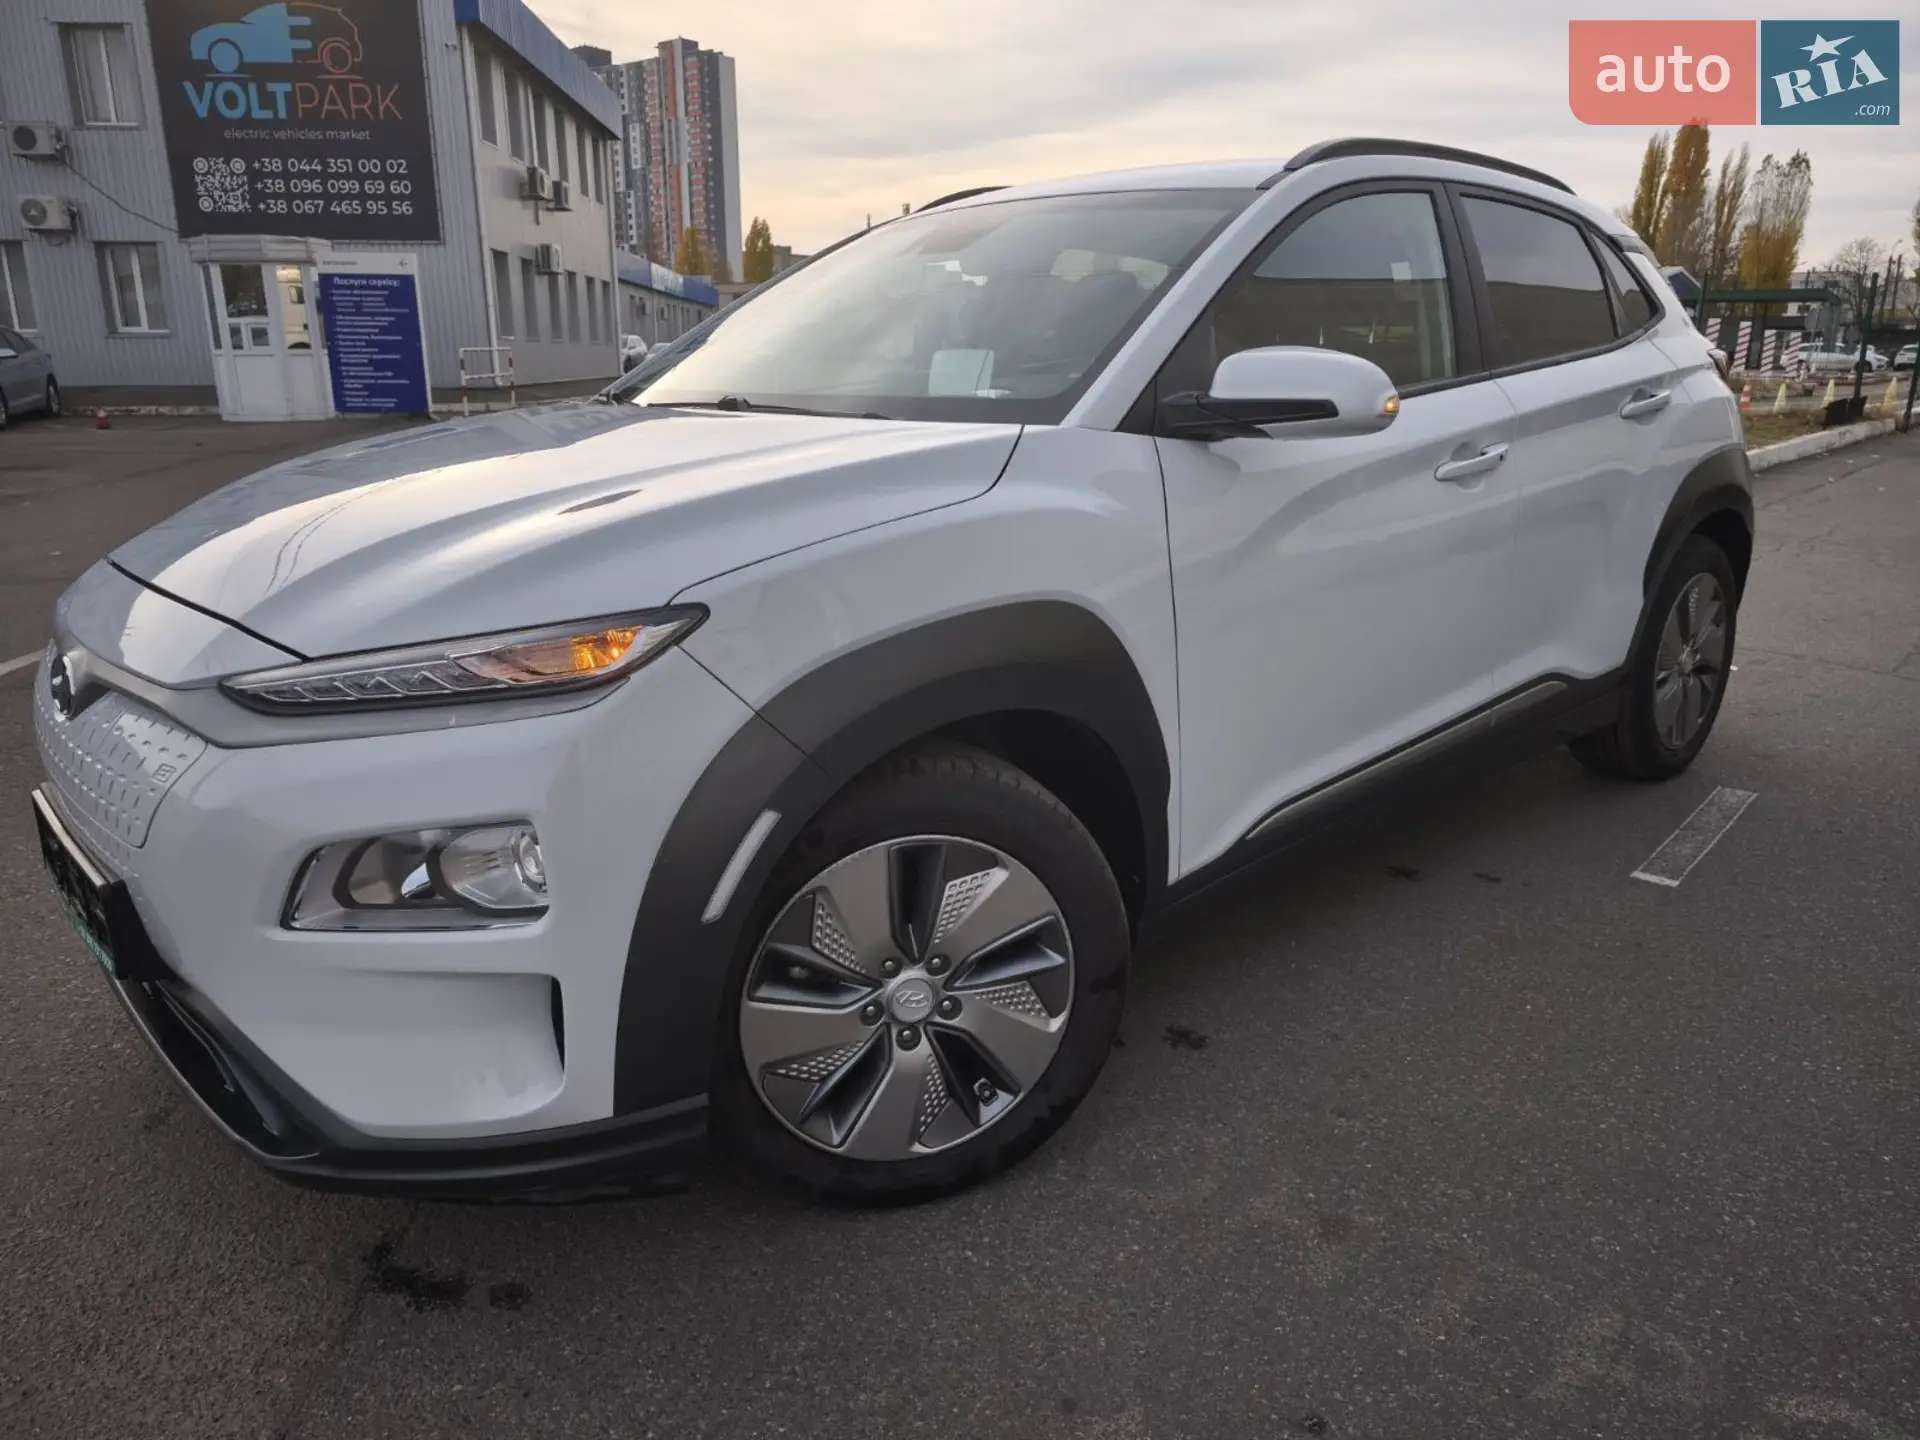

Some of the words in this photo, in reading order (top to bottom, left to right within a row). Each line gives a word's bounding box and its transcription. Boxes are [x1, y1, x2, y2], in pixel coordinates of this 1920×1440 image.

[224, 128, 269, 140] electric
[273, 128, 323, 140] vehicles
[326, 129, 371, 140] market
[252, 158, 283, 172] +38
[288, 158, 322, 172] 044
[326, 158, 353, 172] 351
[358, 159, 381, 173] 00
[386, 159, 408, 173] 02
[254, 179, 285, 193] +38
[290, 179, 323, 193] 096
[327, 180, 359, 194] 099
[364, 180, 385, 194] 69
[390, 180, 411, 194] 60
[257, 200, 288, 213] +38
[292, 200, 324, 213] 067
[330, 200, 362, 214] 465
[366, 201, 387, 214] 95
[392, 201, 413, 214] 56
